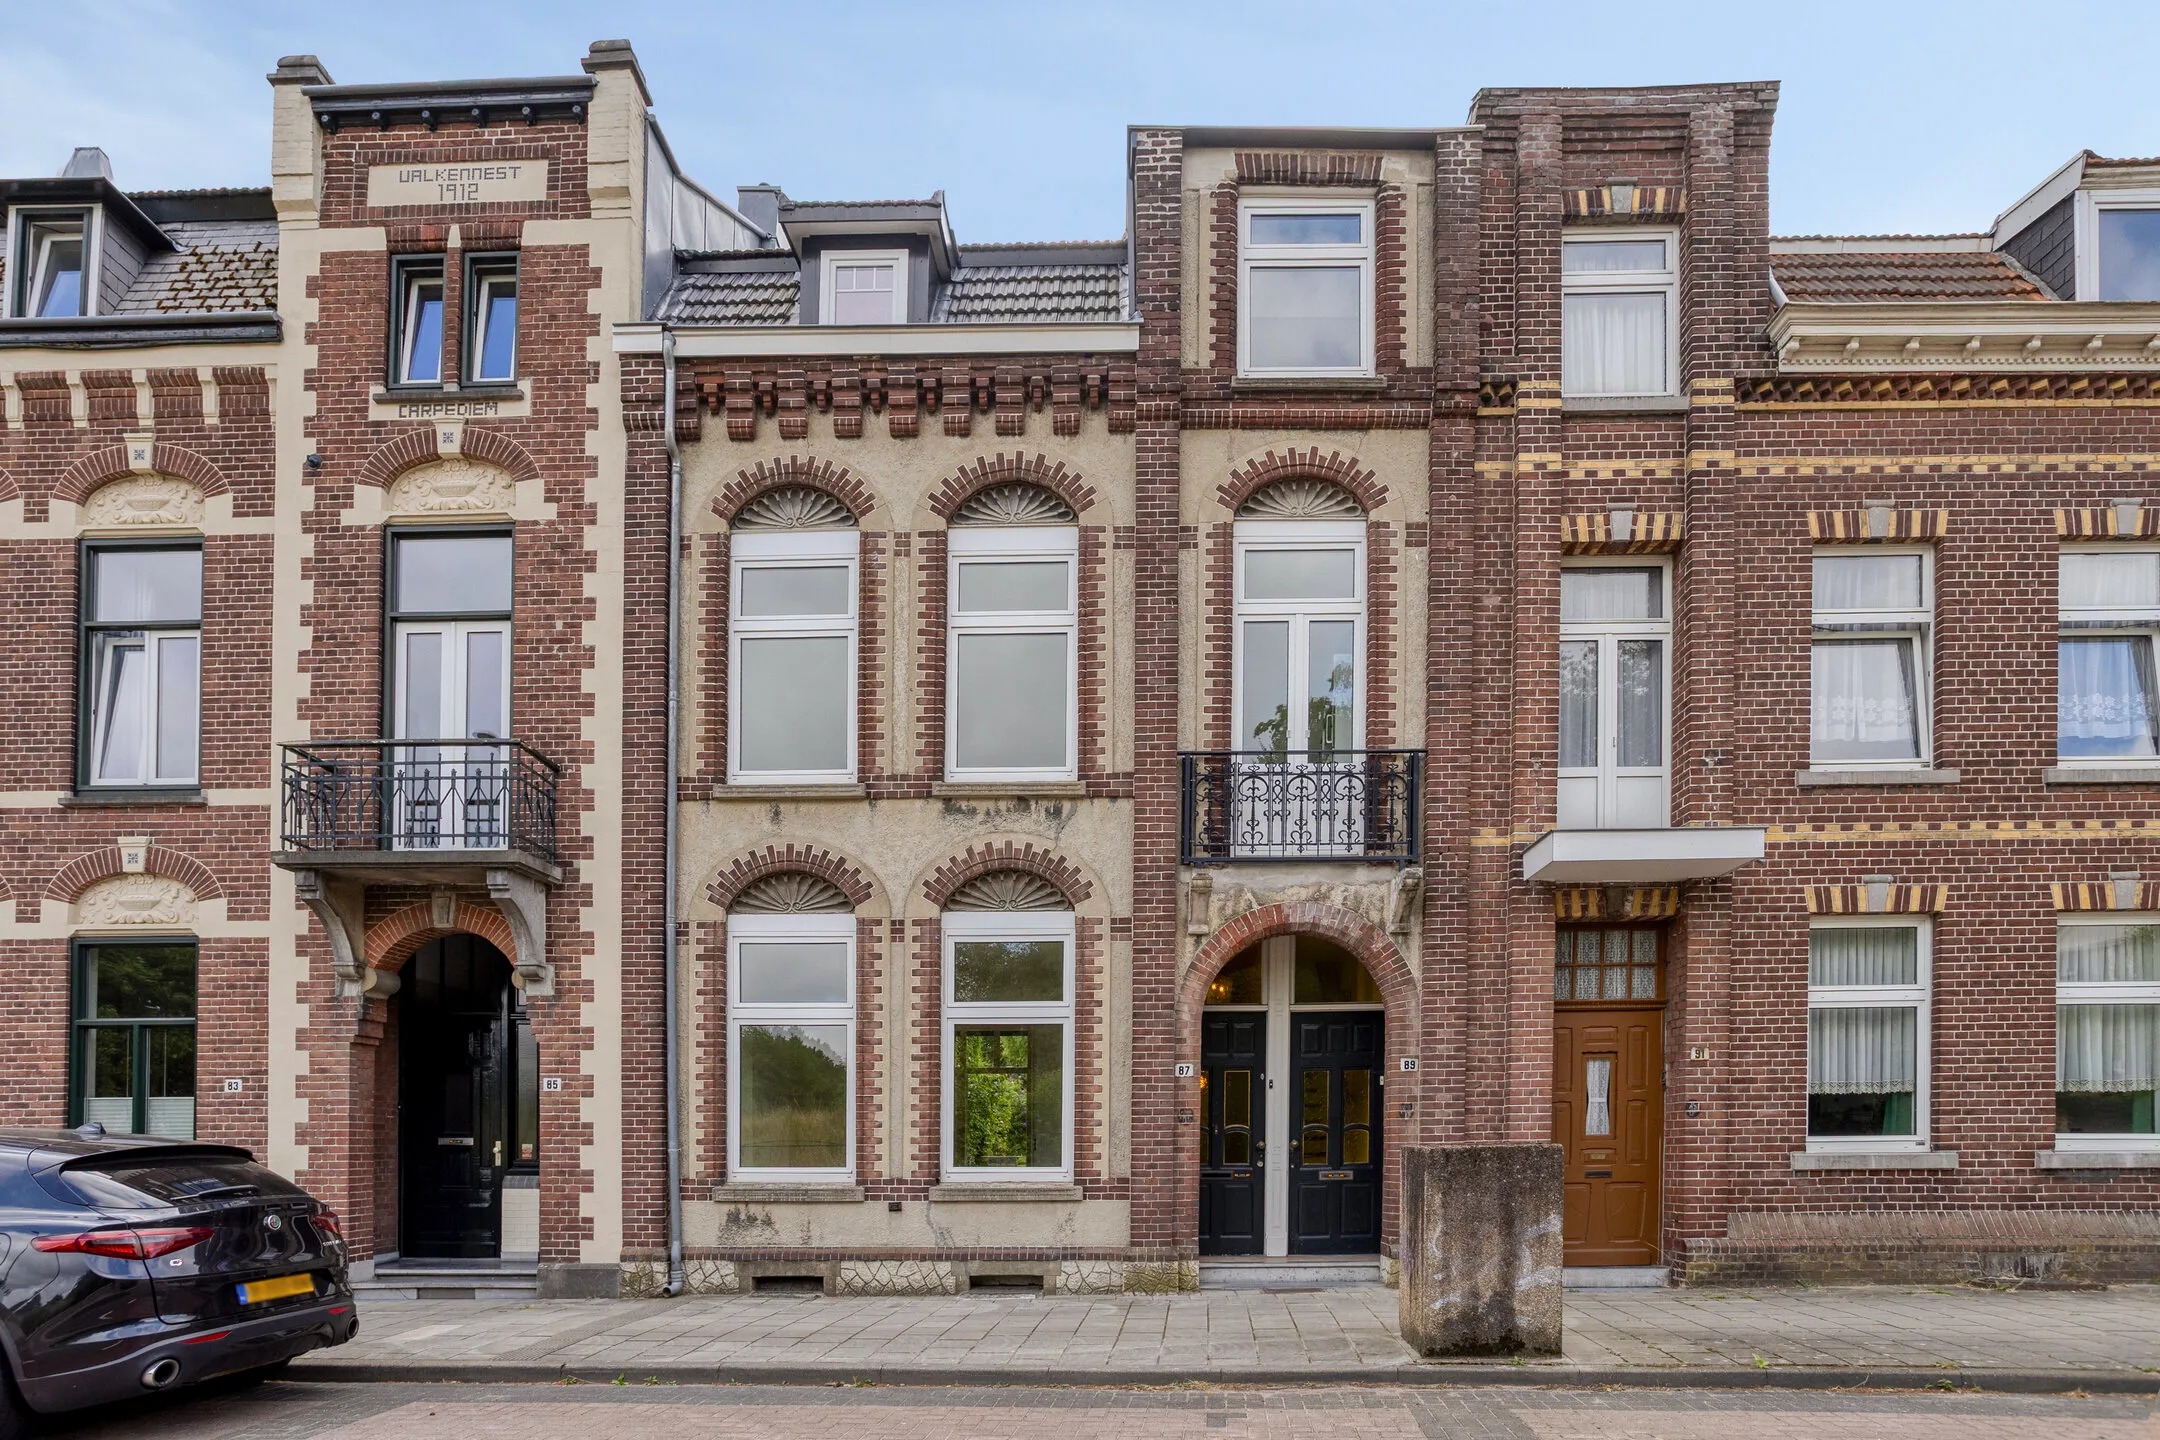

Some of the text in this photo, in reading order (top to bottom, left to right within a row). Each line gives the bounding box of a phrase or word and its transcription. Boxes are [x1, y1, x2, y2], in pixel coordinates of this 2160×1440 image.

[438, 183, 479, 201] 1912
[1695, 1049, 1704, 1059] 91
[1404, 1060, 1416, 1070] 89
[1178, 1065, 1190, 1076] 87
[227, 1081, 239, 1091] 83
[546, 1079, 558, 1090] 85
